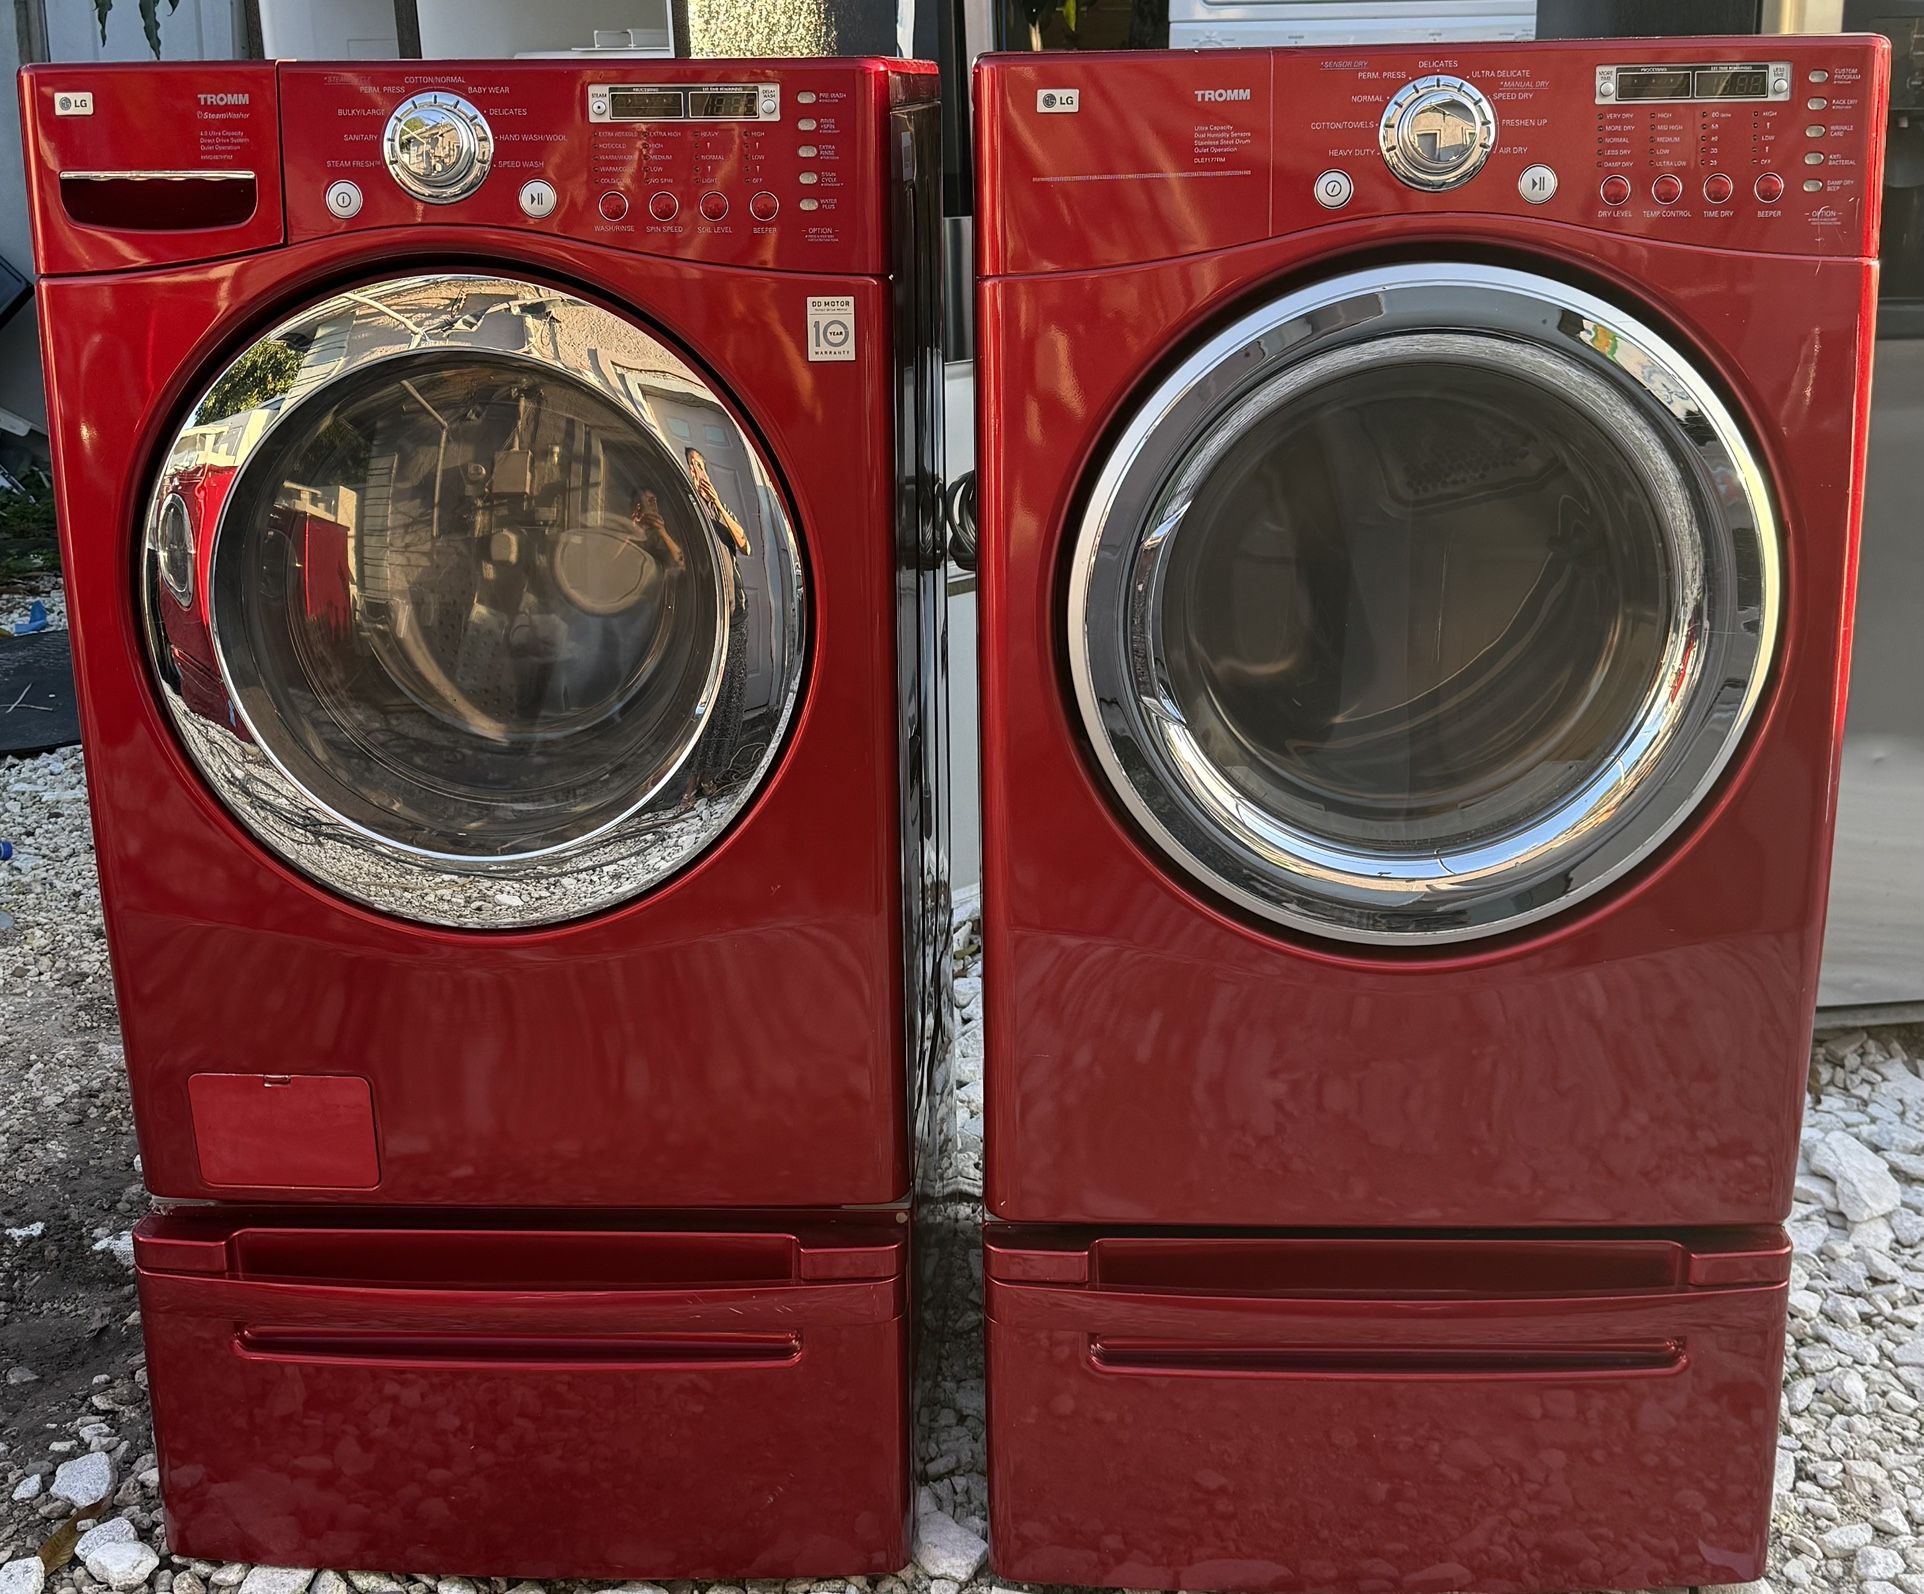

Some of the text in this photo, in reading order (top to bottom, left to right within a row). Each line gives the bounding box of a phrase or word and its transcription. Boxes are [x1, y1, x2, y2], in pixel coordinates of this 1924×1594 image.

[1418, 60, 1458, 68] DELICATES
[1472, 70, 1530, 78] ULTRA DELICATE
[197, 94, 249, 105] TROMM
[1194, 89, 1250, 102] TROMM
[1493, 92, 1534, 100] SPEED DRY
[74, 99, 87, 107] LG
[1060, 96, 1074, 105] LG
[489, 108, 527, 116] DELICATES
[1311, 121, 1374, 130] COTTON/TOWELS
[1354, 148, 1376, 156] DUTY
[1662, 210, 1692, 218] CONTROL
[1704, 210, 1734, 218] TIME DRY
[814, 320, 850, 348] 10
